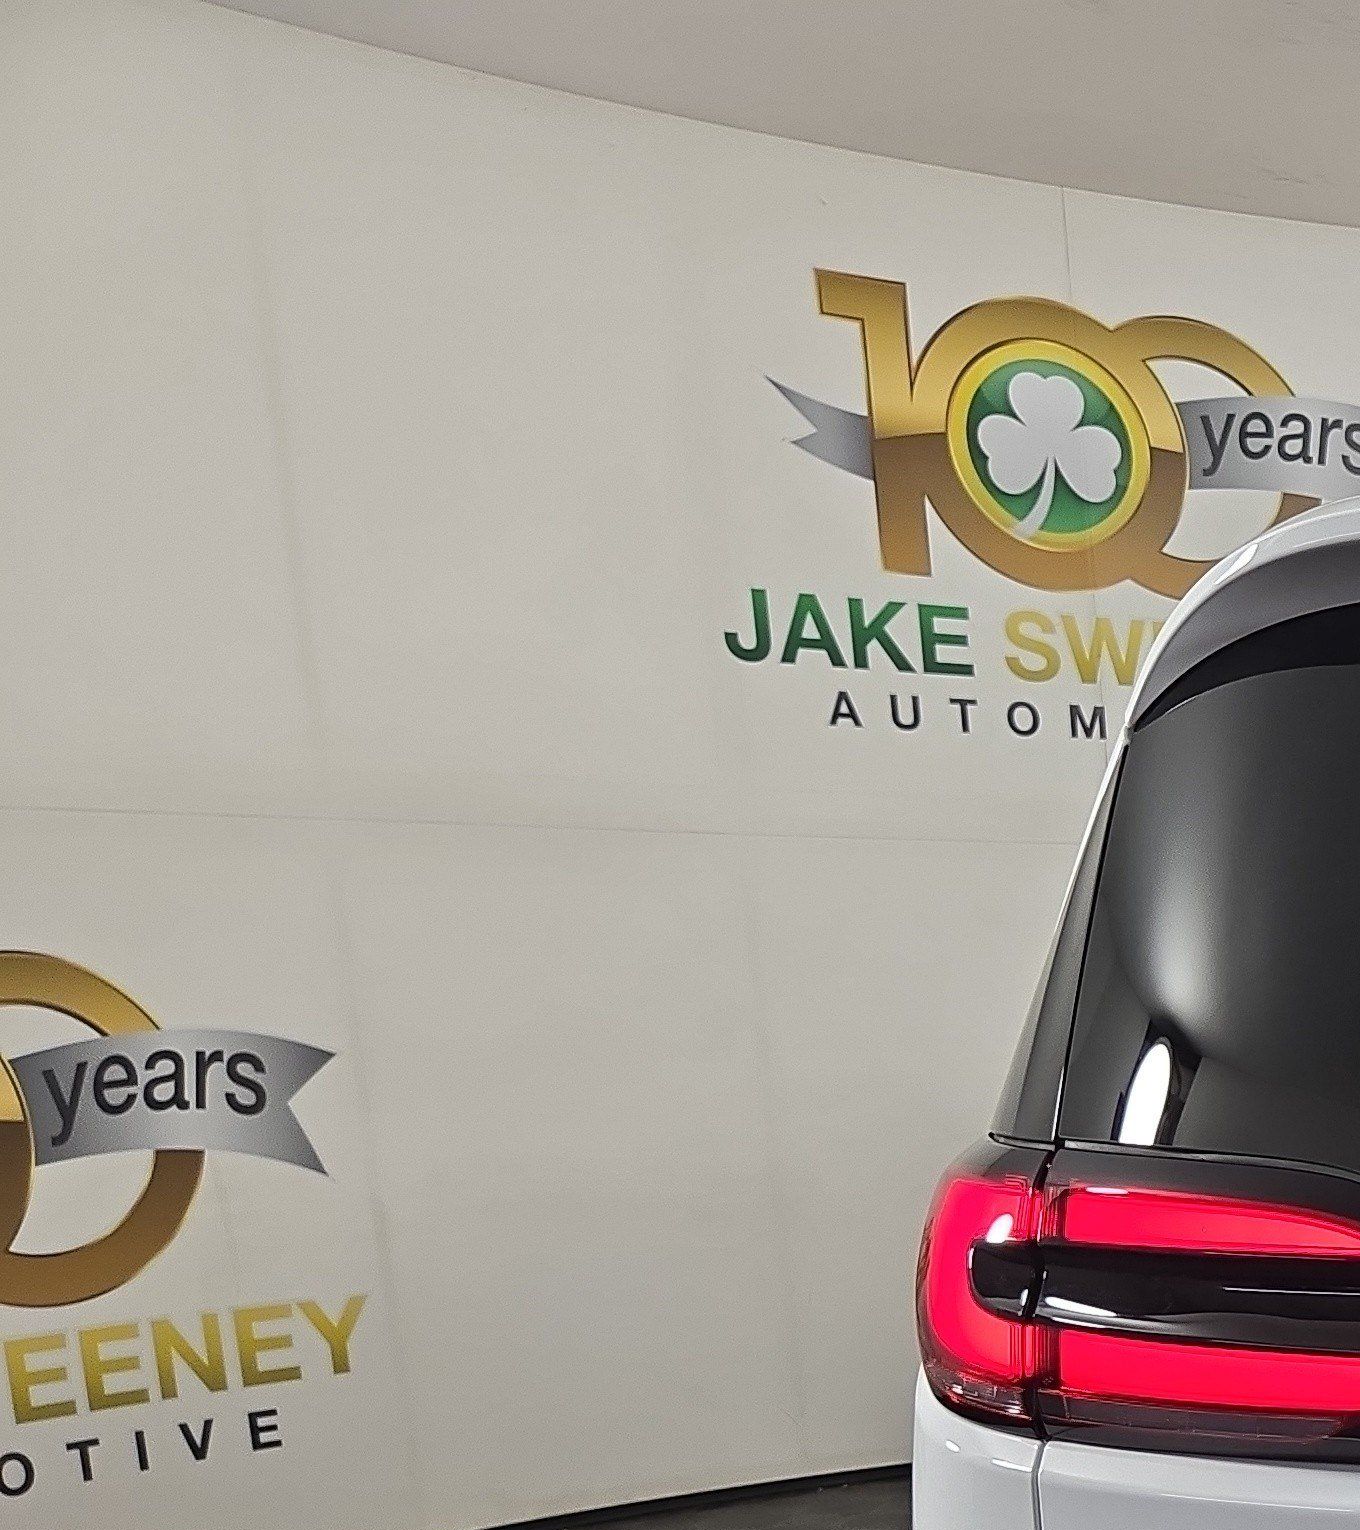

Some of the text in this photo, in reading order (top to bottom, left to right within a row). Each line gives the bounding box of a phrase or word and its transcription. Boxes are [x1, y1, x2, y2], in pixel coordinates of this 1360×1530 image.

[724, 587, 1166, 686] JAKE SW
[829, 690, 1107, 740] AUTOM
[42, 1047, 267, 1146] years
[3, 1295, 366, 1424] EENEY
[0, 1409, 283, 1496] OTIVE
